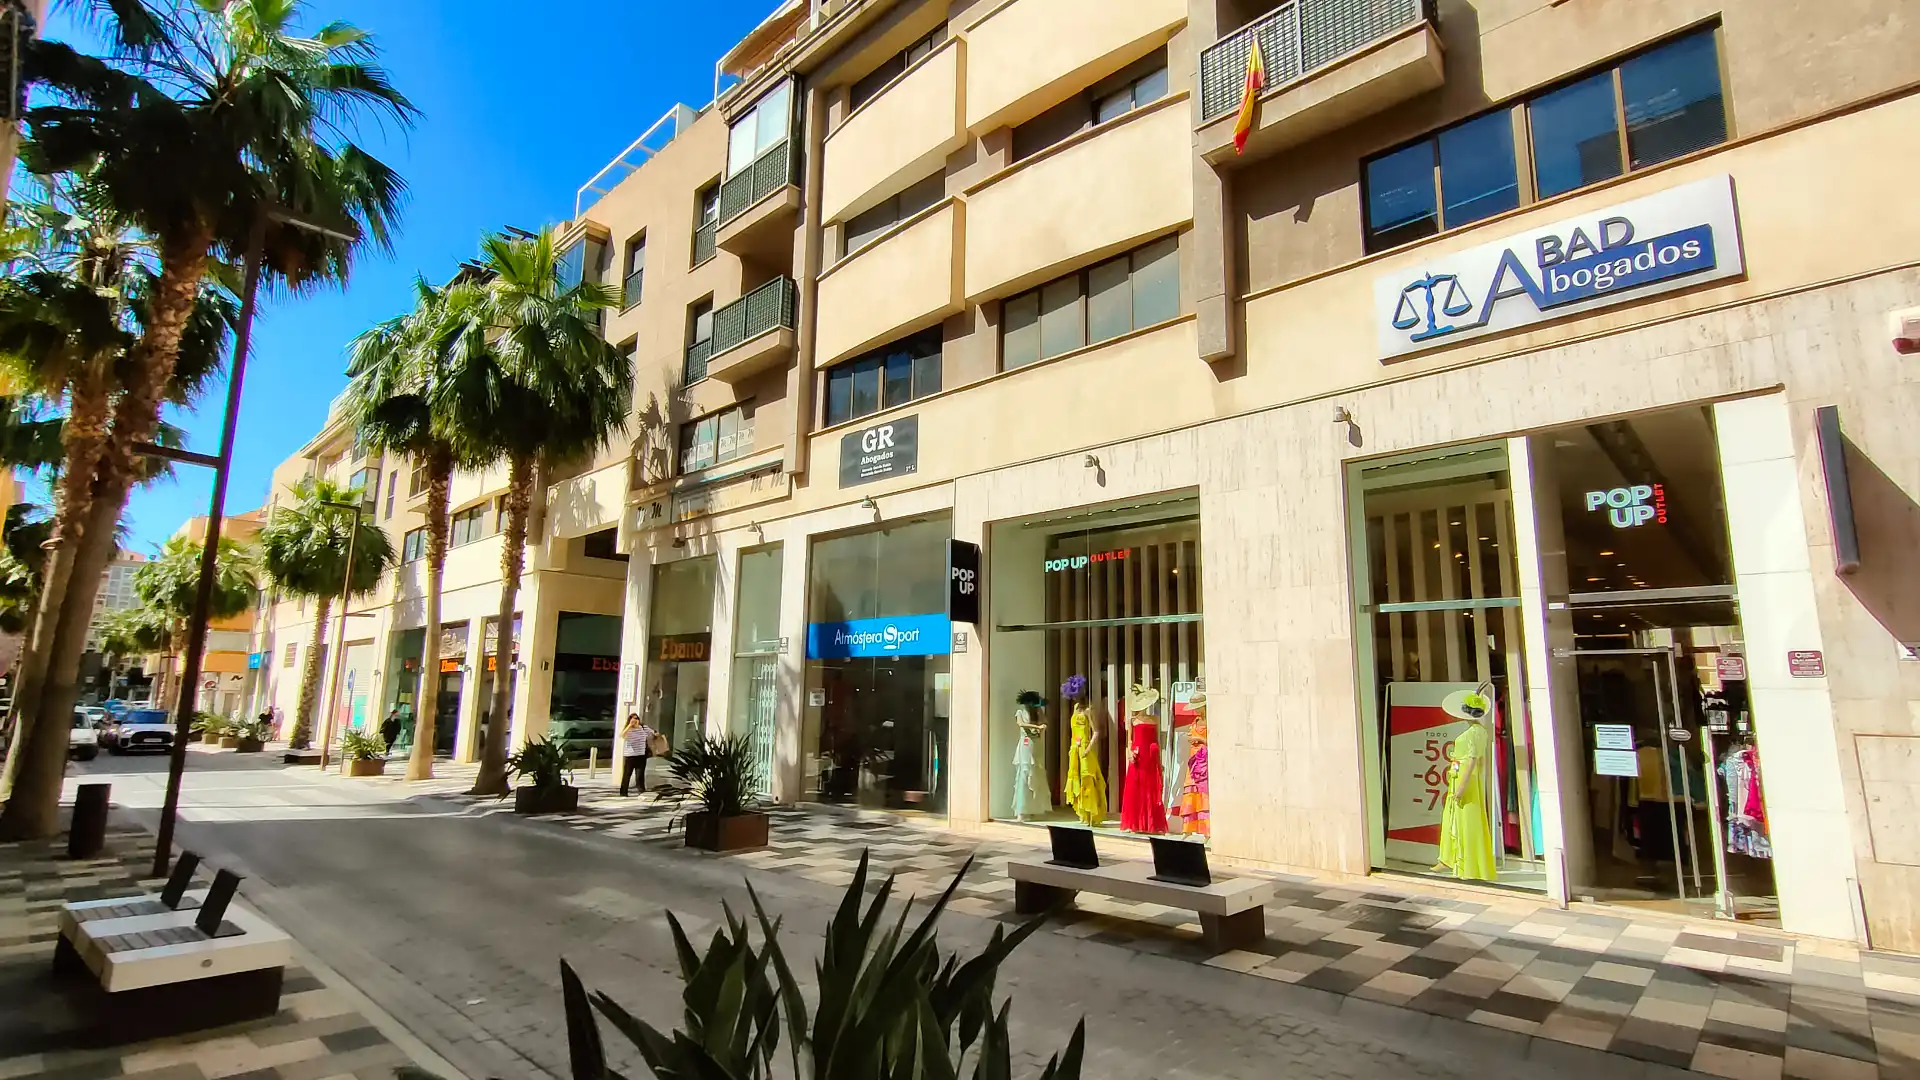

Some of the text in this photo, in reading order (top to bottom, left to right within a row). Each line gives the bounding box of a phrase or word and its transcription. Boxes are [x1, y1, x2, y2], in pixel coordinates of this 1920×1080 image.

[862, 425, 895, 453] GR
[861, 451, 894, 465] Abogados
[1586, 485, 1652, 511] POP
[1654, 483, 1667, 524] OUTLET
[1610, 505, 1655, 528] UP
[1045, 547, 1131, 572] POP UP OUTLET
[952, 566, 975, 581] POP
[960, 581, 975, 595] UP
[883, 623, 920, 650] Sport
[592, 657, 621, 671] Eba
[1176, 683, 1193, 693] UP
[1413, 789, 1448, 811] -7
